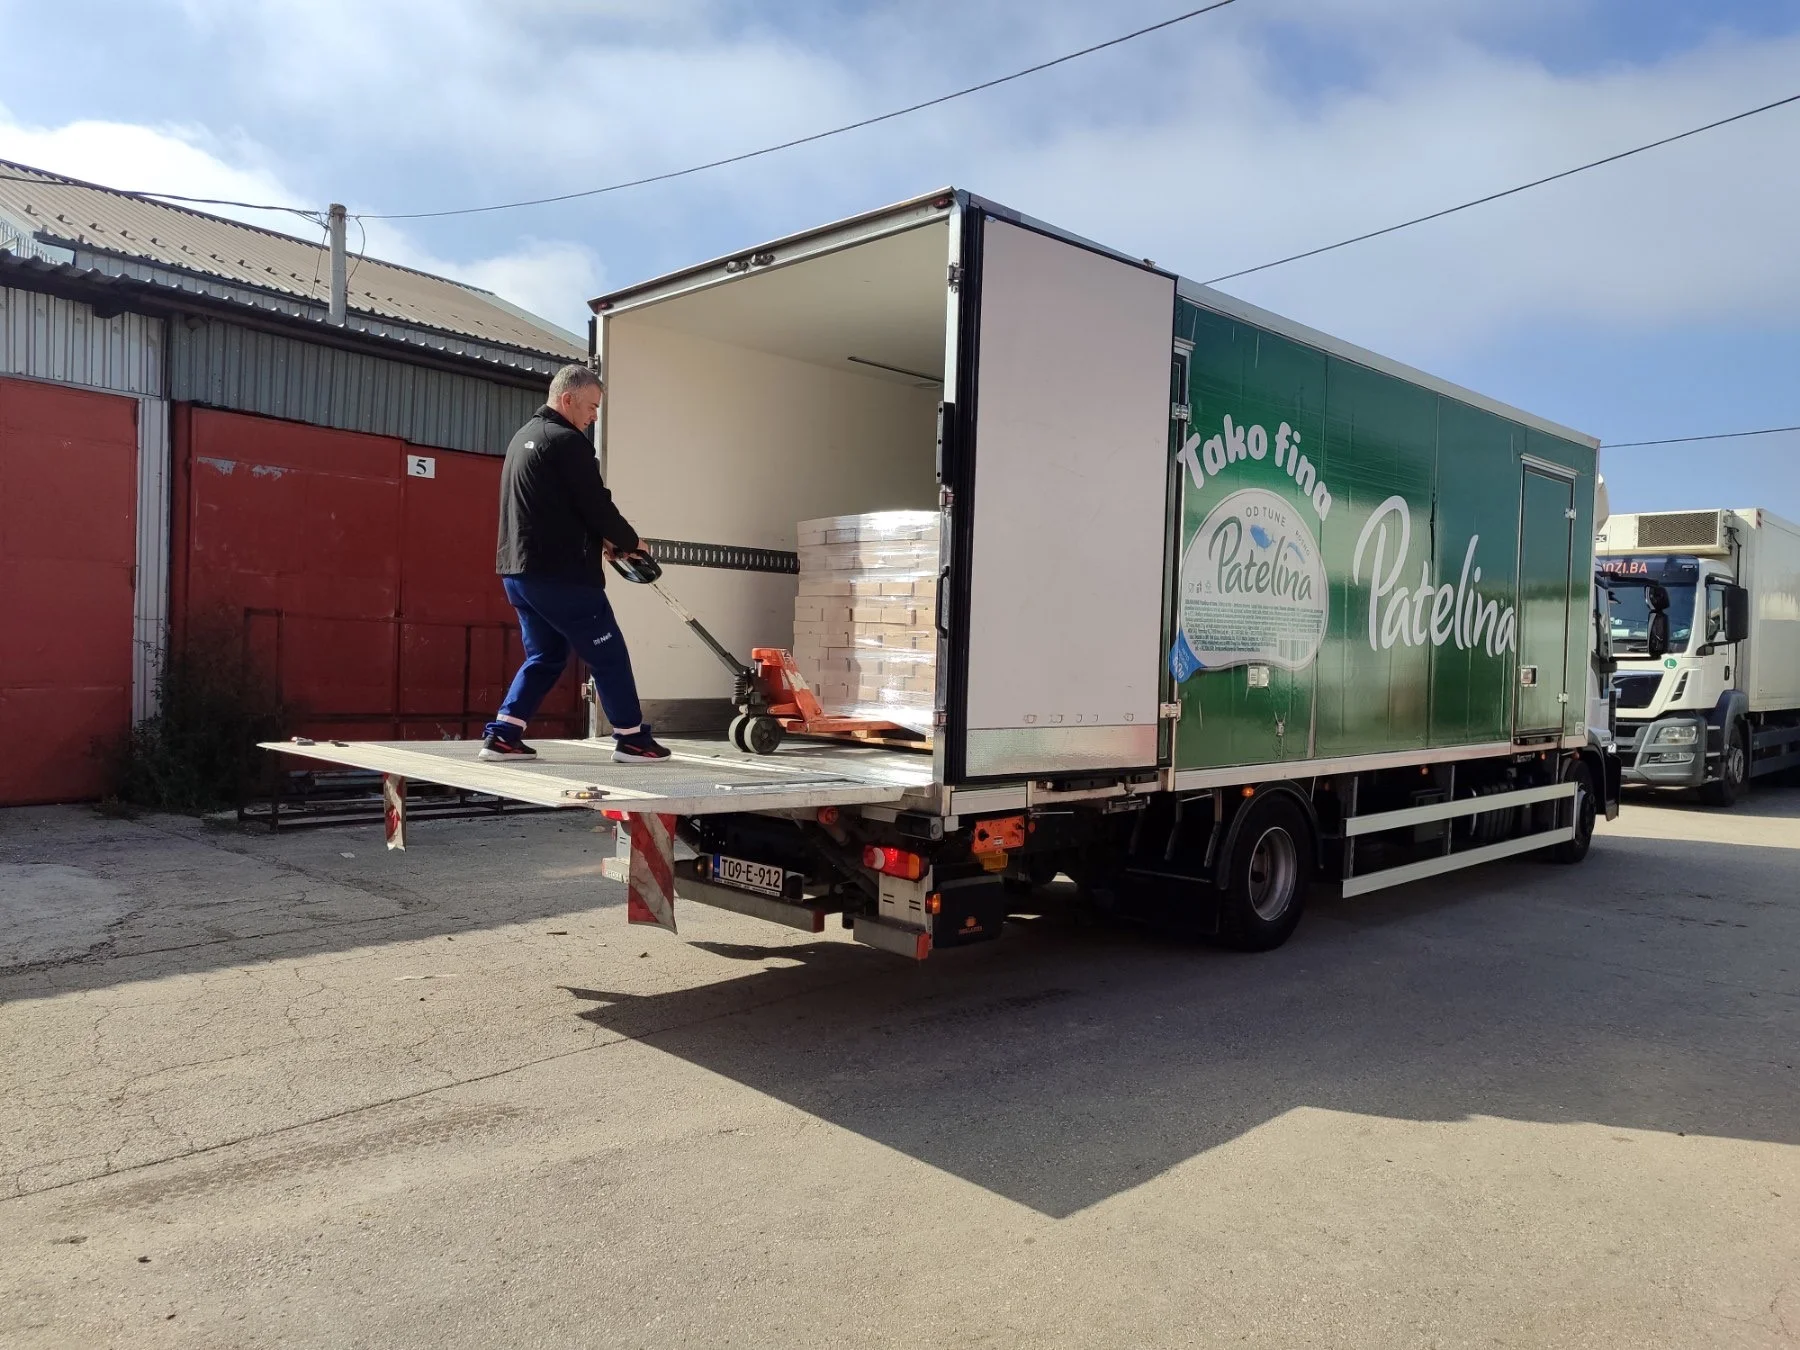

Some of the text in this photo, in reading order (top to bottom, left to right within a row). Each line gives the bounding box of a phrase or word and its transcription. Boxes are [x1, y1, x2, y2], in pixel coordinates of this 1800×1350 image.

[416, 459, 427, 475] 5
[1176, 413, 1332, 521] Tako fina
[1245, 505, 1287, 527] OD TUNE
[1208, 515, 1312, 601] Patelina
[1602, 562, 1648, 574] OZI.BA
[1353, 495, 1516, 658] Patelina
[721, 858, 781, 888] T09-E-912
